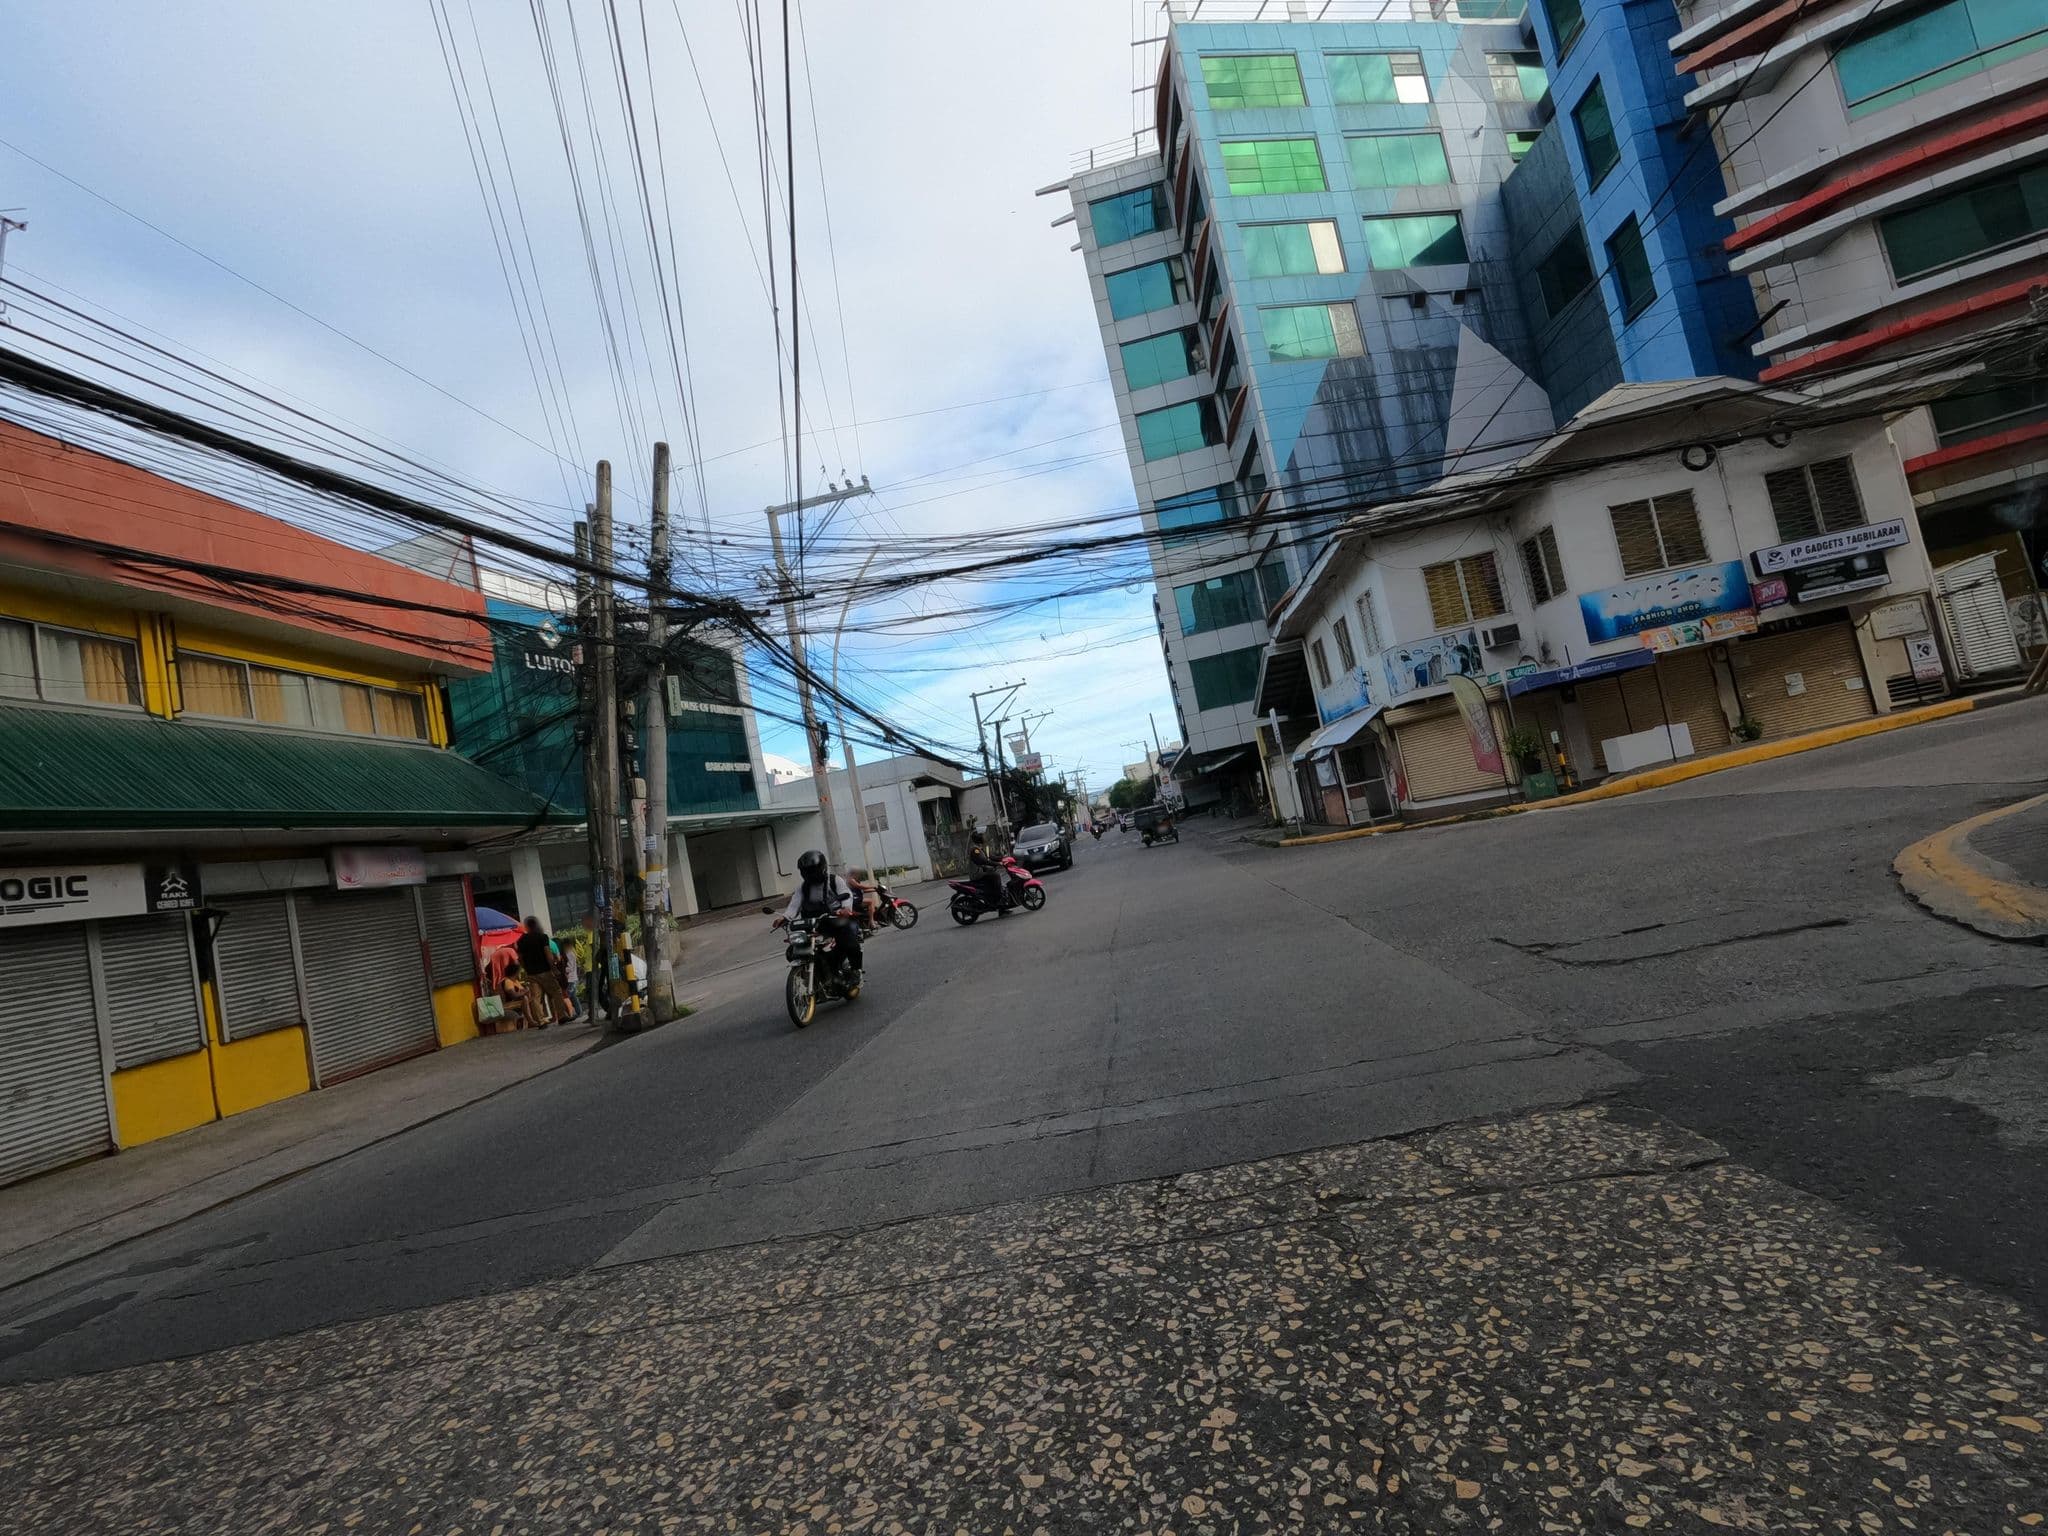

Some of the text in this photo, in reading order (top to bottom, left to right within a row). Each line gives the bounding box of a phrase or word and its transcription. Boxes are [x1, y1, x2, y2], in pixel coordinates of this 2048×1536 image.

[1790, 547, 1802, 558] KP
[1805, 537, 1844, 554] GADGETS
[1846, 525, 1901, 544] TAGBILARAN
[1633, 609, 1673, 623] FASHION
[1677, 602, 1701, 614] SHOP
[161, 891, 189, 899] RAKK
